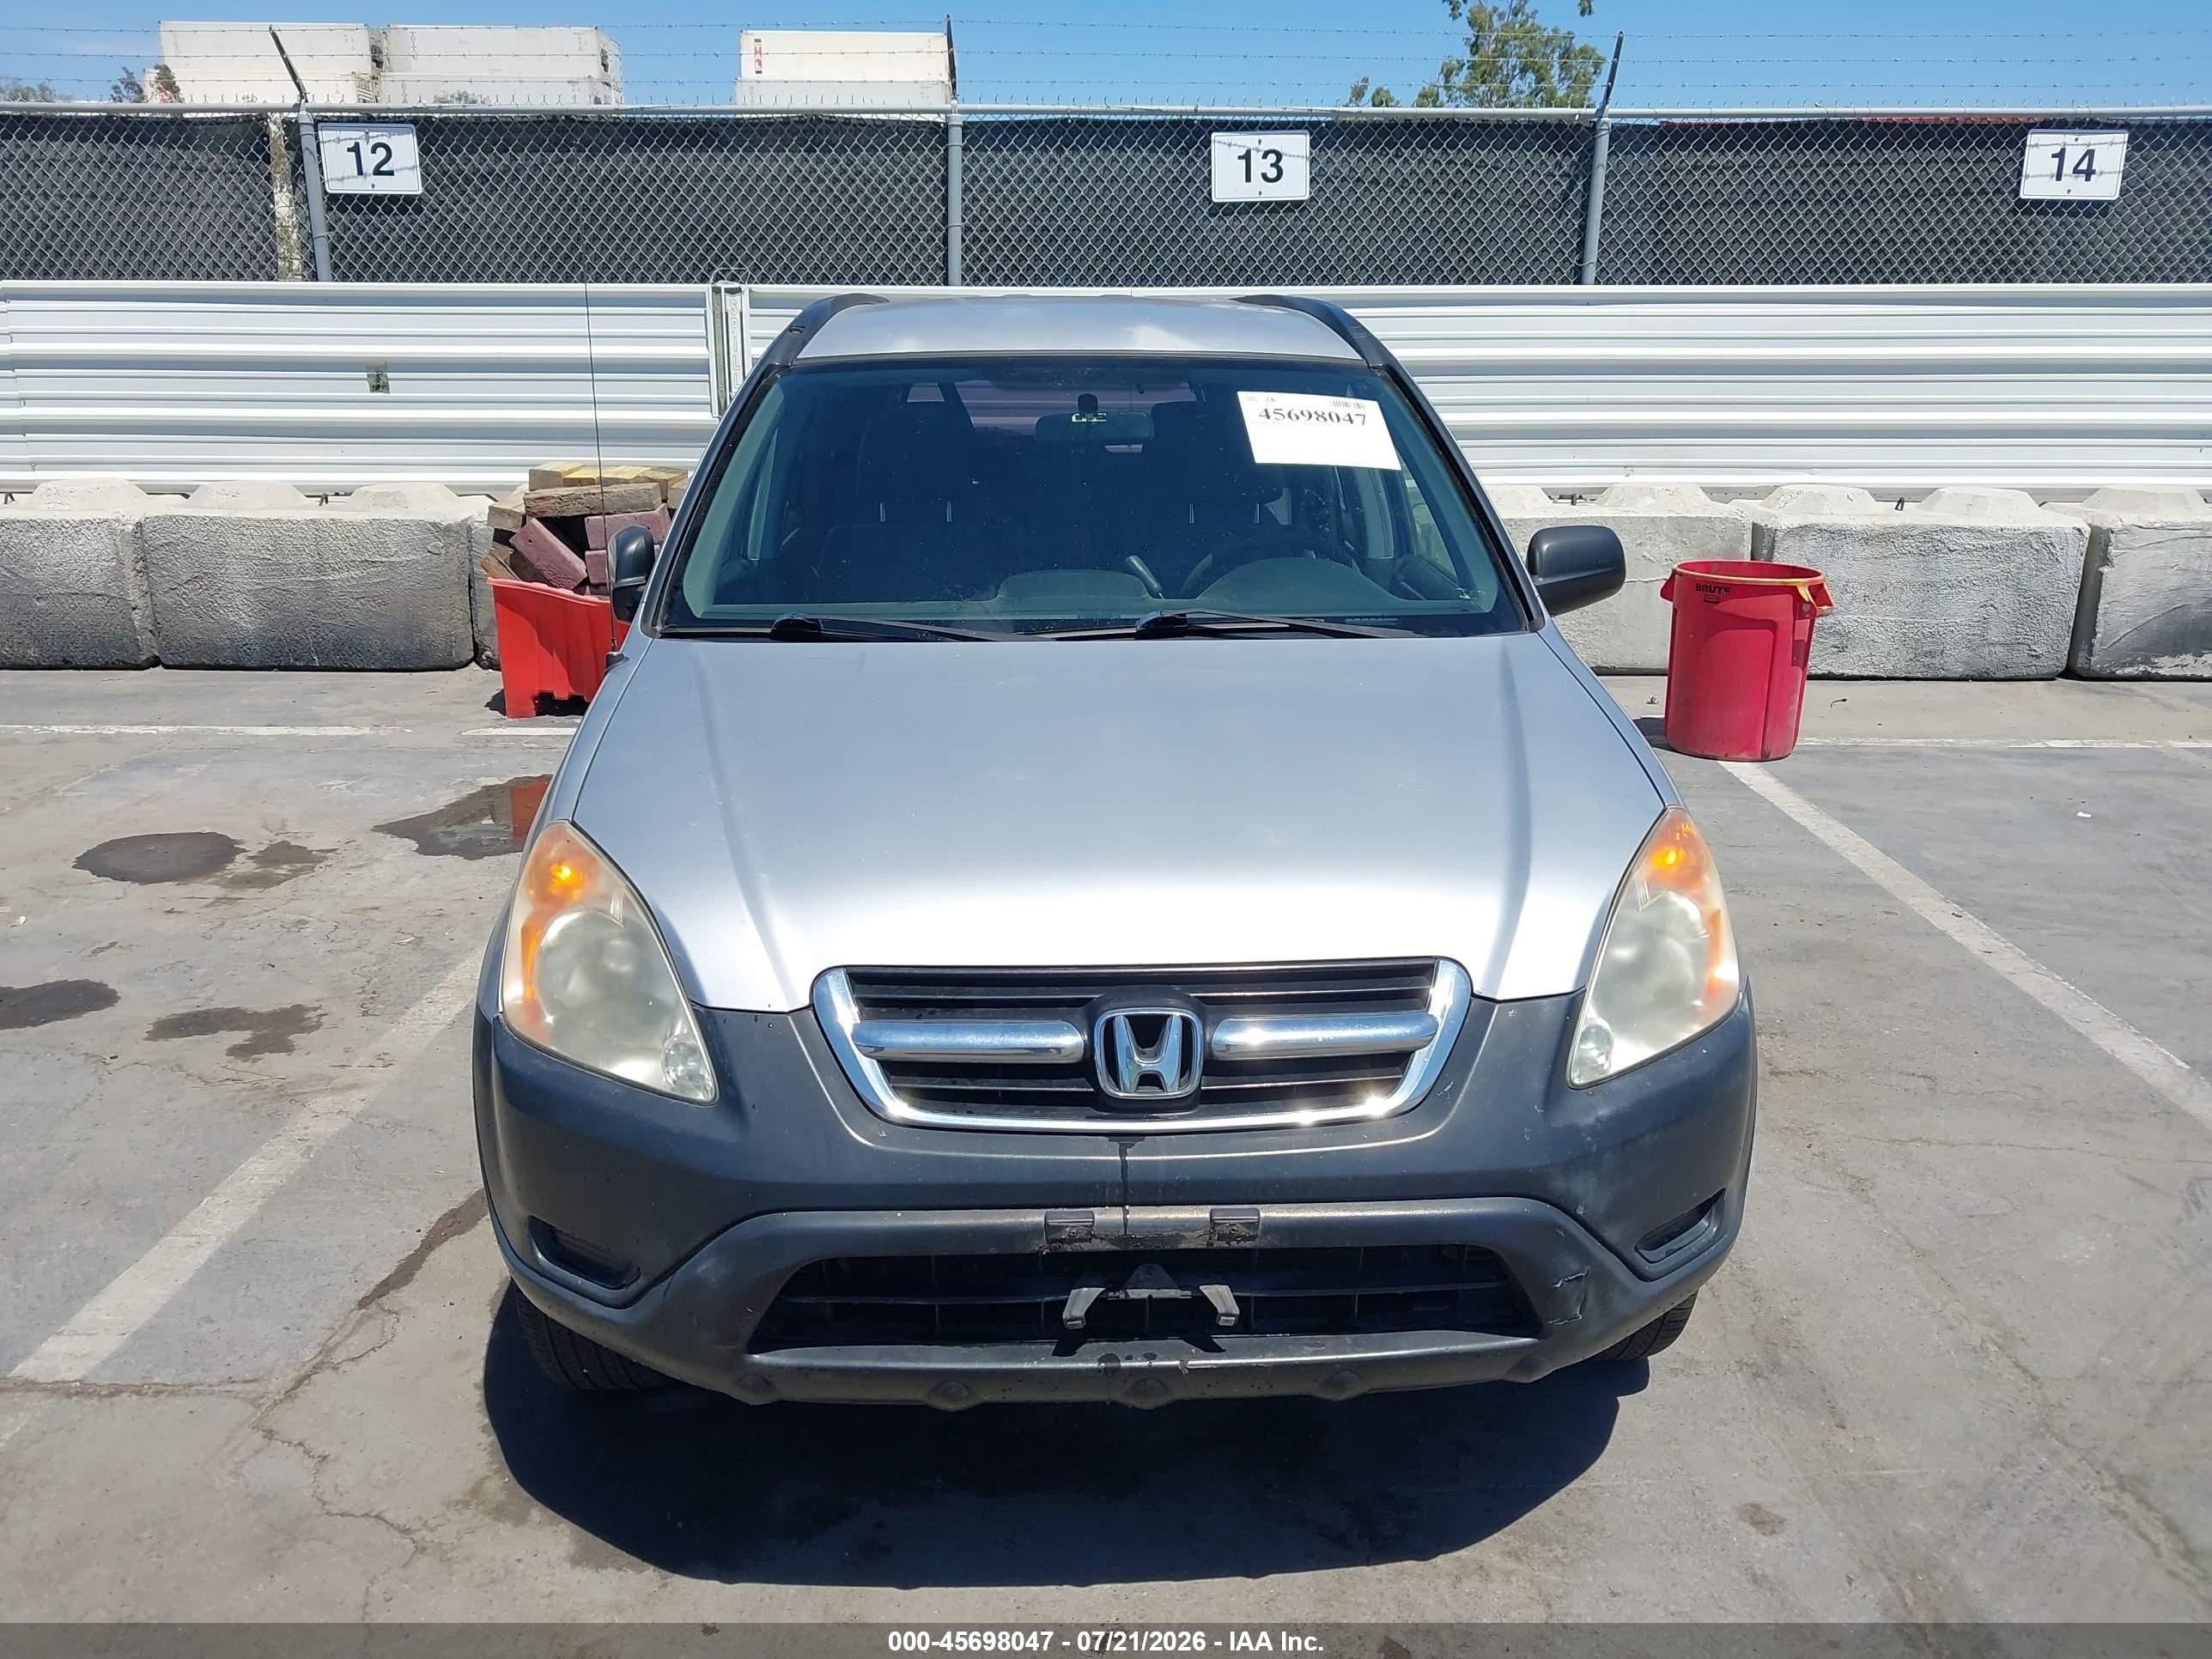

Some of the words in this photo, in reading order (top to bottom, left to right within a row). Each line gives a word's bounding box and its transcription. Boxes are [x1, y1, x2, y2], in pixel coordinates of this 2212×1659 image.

[346, 142, 395, 177] 12
[1237, 149, 1284, 183] 13
[2051, 148, 2096, 182] 14
[1258, 408, 1366, 426] 45698047
